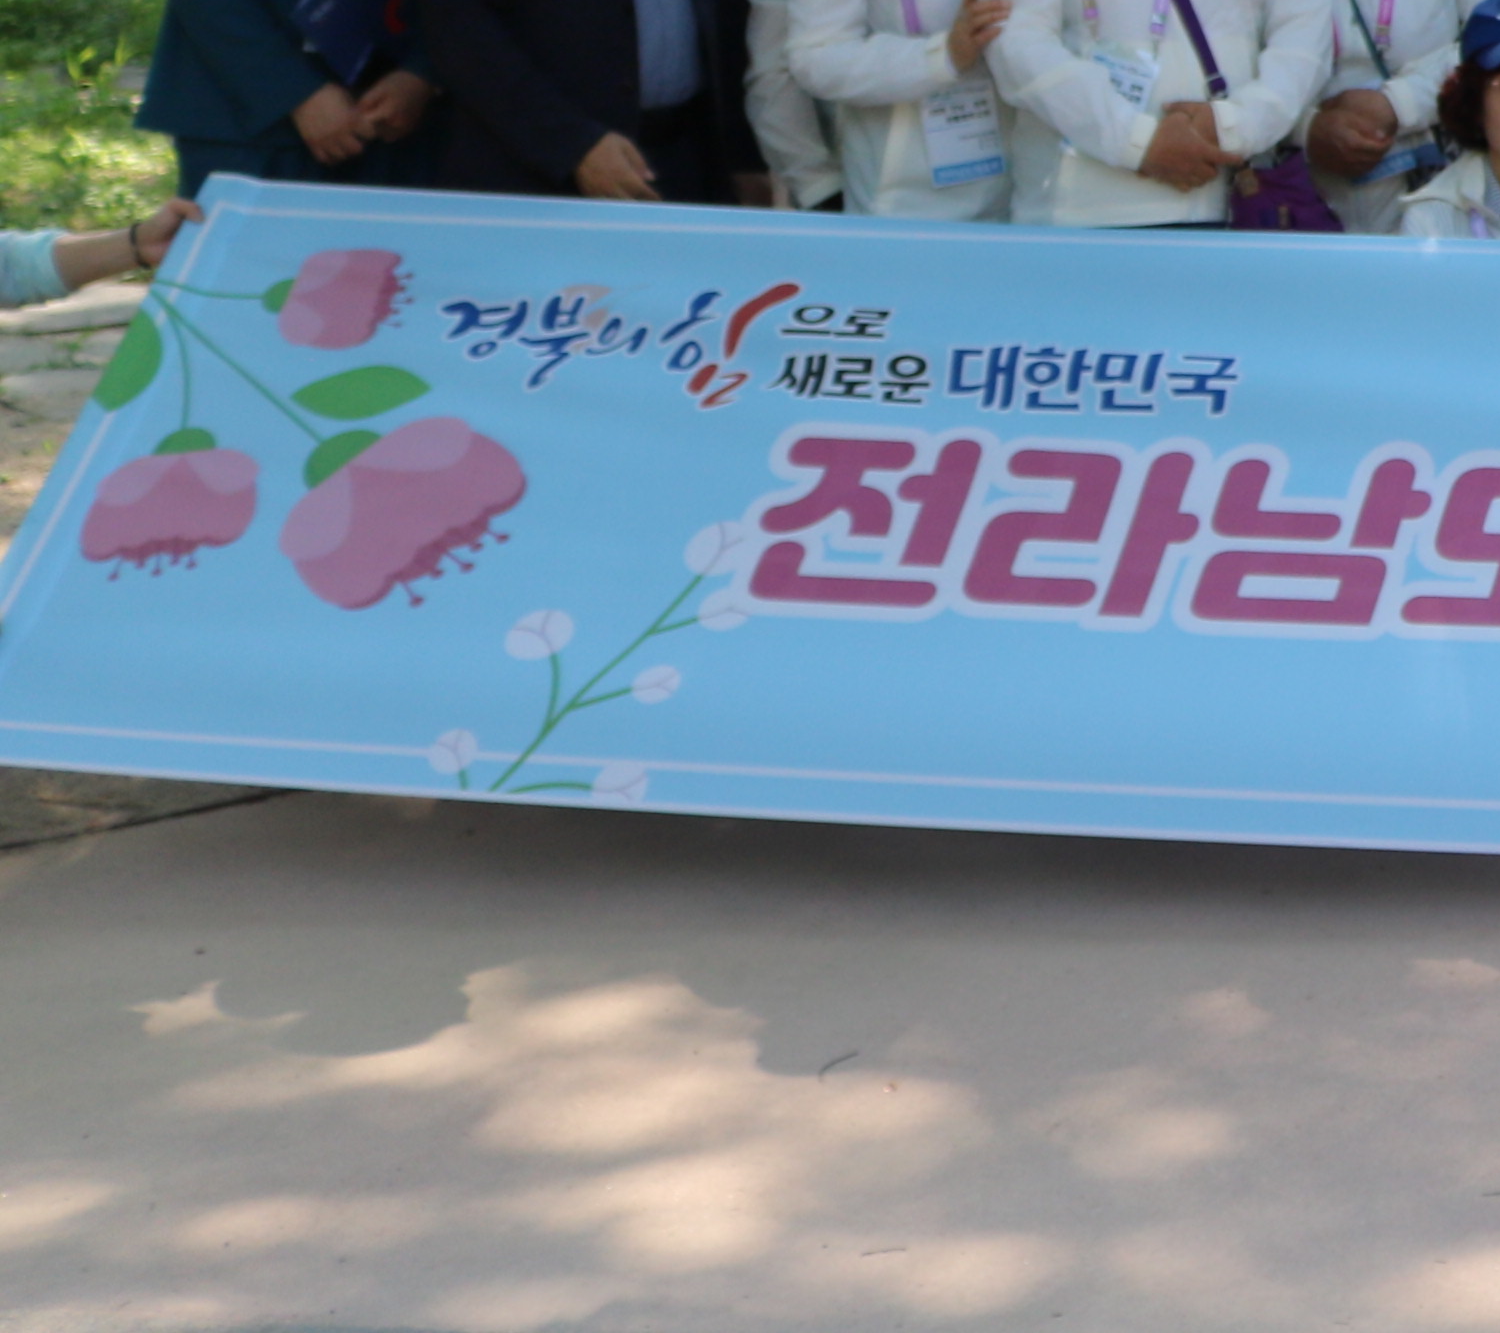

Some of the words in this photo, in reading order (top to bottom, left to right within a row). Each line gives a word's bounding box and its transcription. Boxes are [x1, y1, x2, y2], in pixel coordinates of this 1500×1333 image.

[441, 295, 647, 390] 경북의
[774, 354, 931, 405] 새로운
[948, 346, 1238, 414] 대한민국
